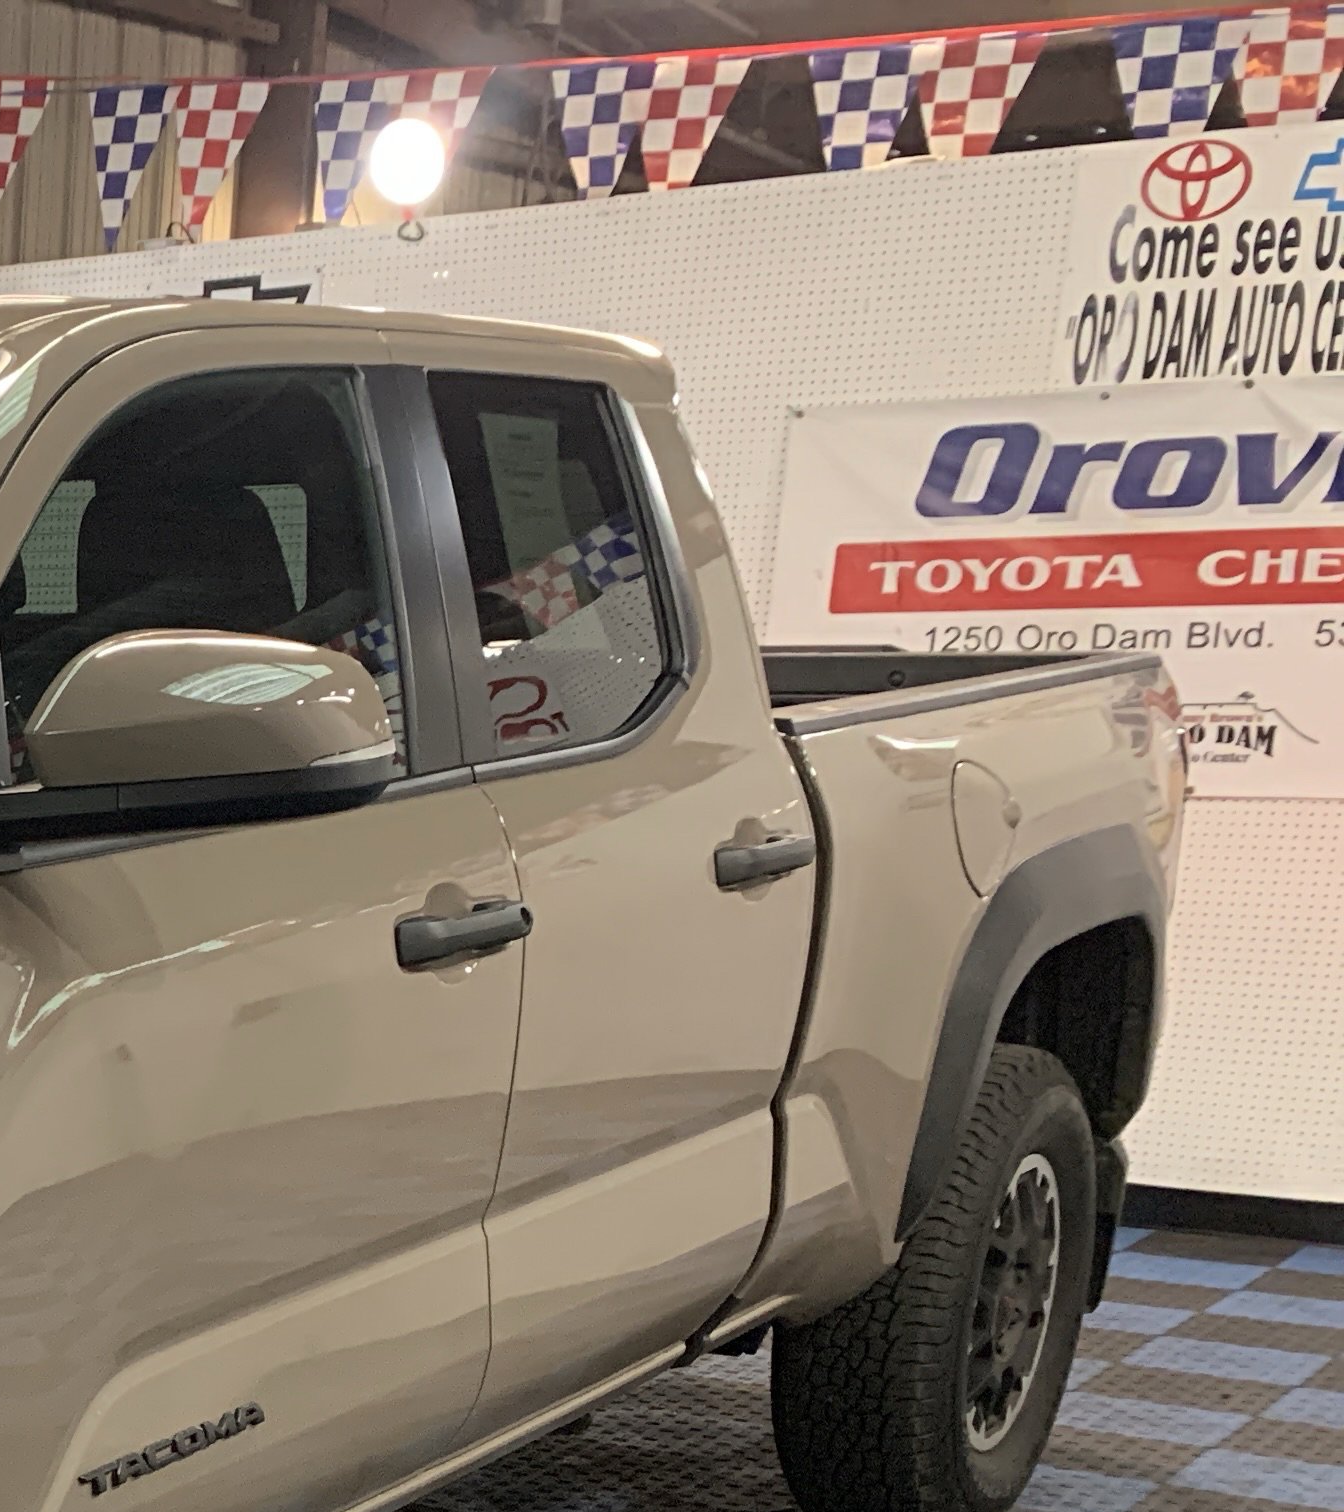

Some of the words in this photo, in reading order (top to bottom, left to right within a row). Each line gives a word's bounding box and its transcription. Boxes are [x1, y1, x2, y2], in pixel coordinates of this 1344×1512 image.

[1109, 204, 1220, 283] Come
[1231, 217, 1302, 275] see
[1315, 215, 1344, 271] u
[1142, 287, 1218, 379] DAM
[1218, 280, 1306, 377] AUTO
[869, 554, 1142, 594] TOYOTA
[925, 625, 1003, 653] 1250
[1016, 624, 1078, 651] Oro
[1092, 622, 1172, 650] Dam
[1185, 620, 1274, 649] Blvd.
[1216, 725, 1278, 757] DAM
[77, 1400, 266, 1497] TACOMA
